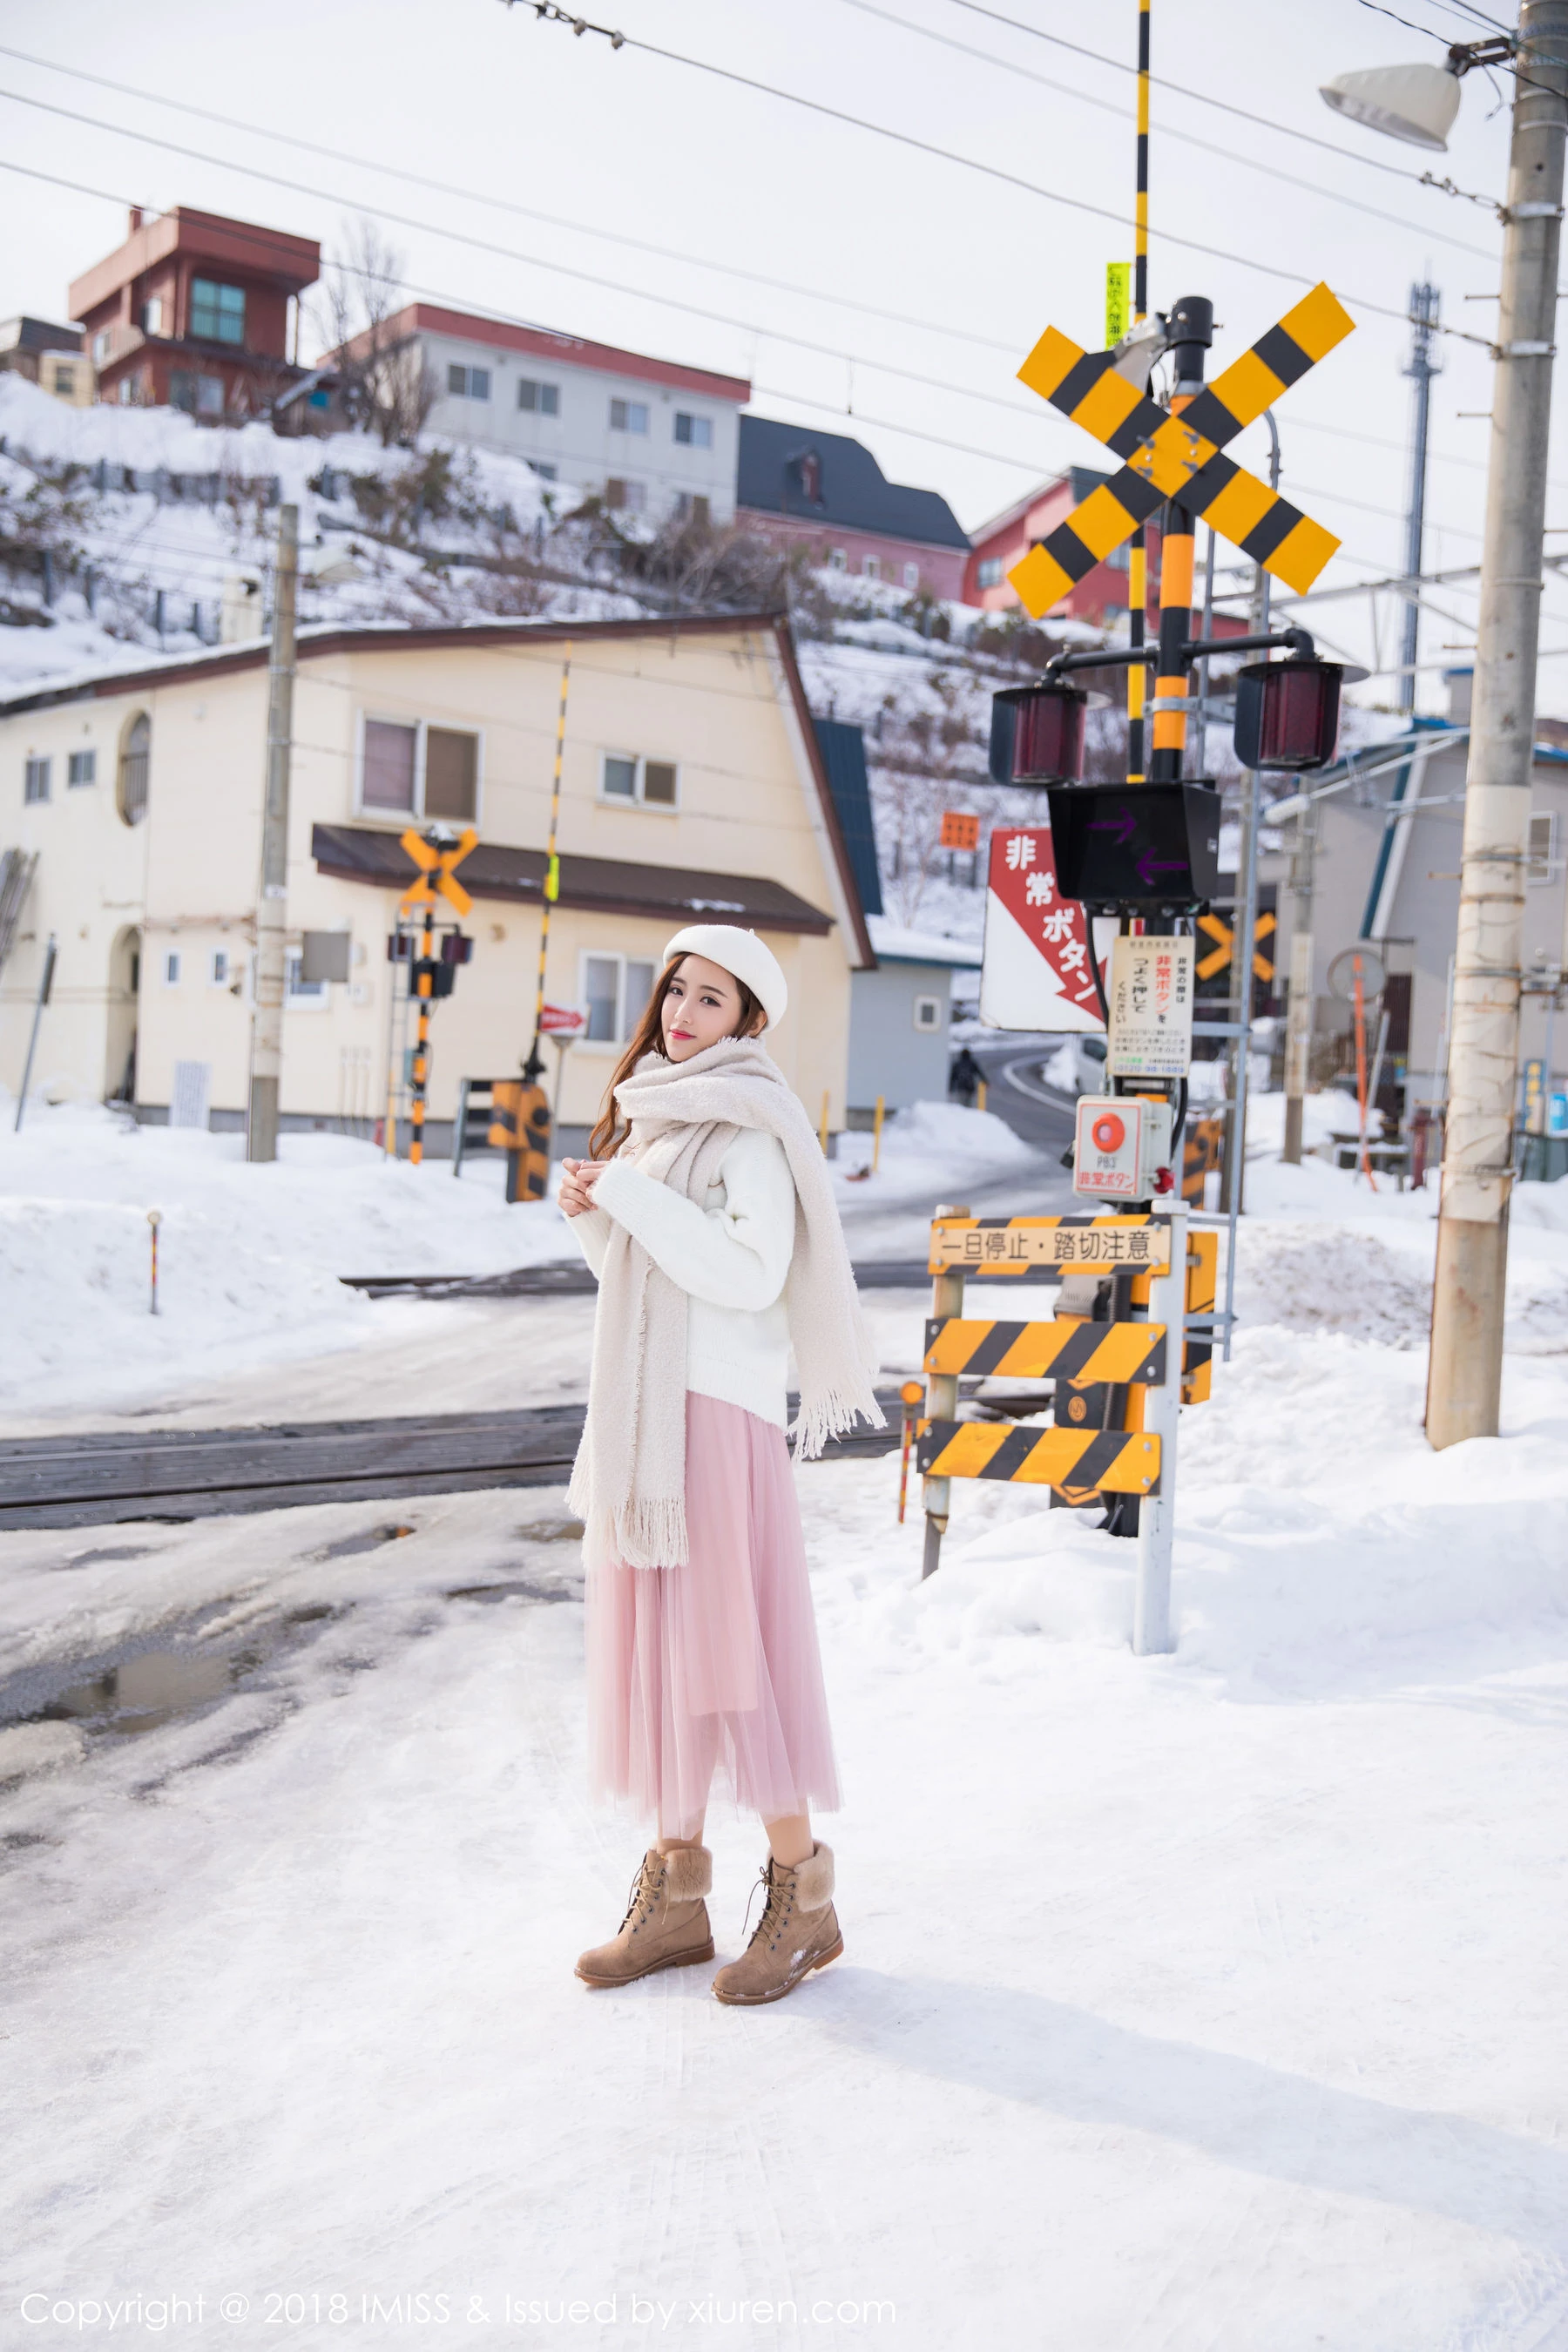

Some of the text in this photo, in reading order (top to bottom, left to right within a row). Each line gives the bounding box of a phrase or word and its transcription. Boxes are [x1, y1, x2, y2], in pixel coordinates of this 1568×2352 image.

[1004, 835, 1097, 1003] 非常ボタン
[1155, 955, 1172, 1024] 非常ボタンを
[1079, 1171, 1135, 1189] 非常ボタン
[942, 1231, 1151, 1260] 一旦停止・踏切注意
